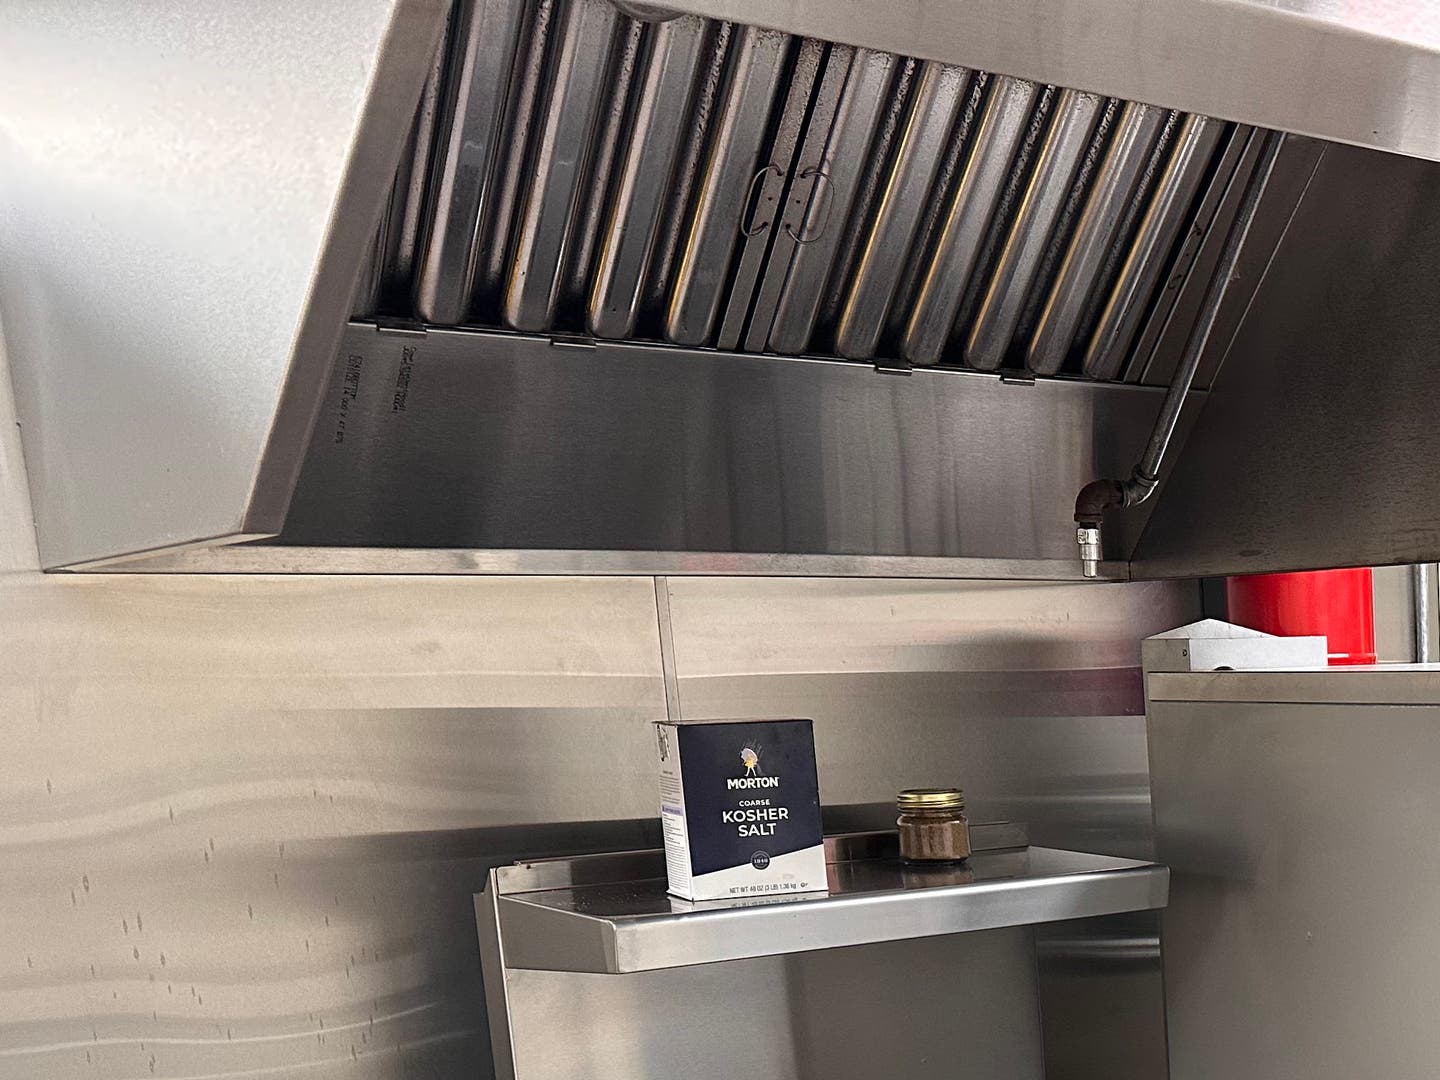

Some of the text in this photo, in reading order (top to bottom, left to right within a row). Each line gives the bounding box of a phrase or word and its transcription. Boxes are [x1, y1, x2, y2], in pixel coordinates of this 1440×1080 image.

[727, 776, 780, 790] MORTON
[738, 798, 771, 807] COARSE
[722, 807, 789, 824] KOSHER
[738, 822, 777, 838] SALT
